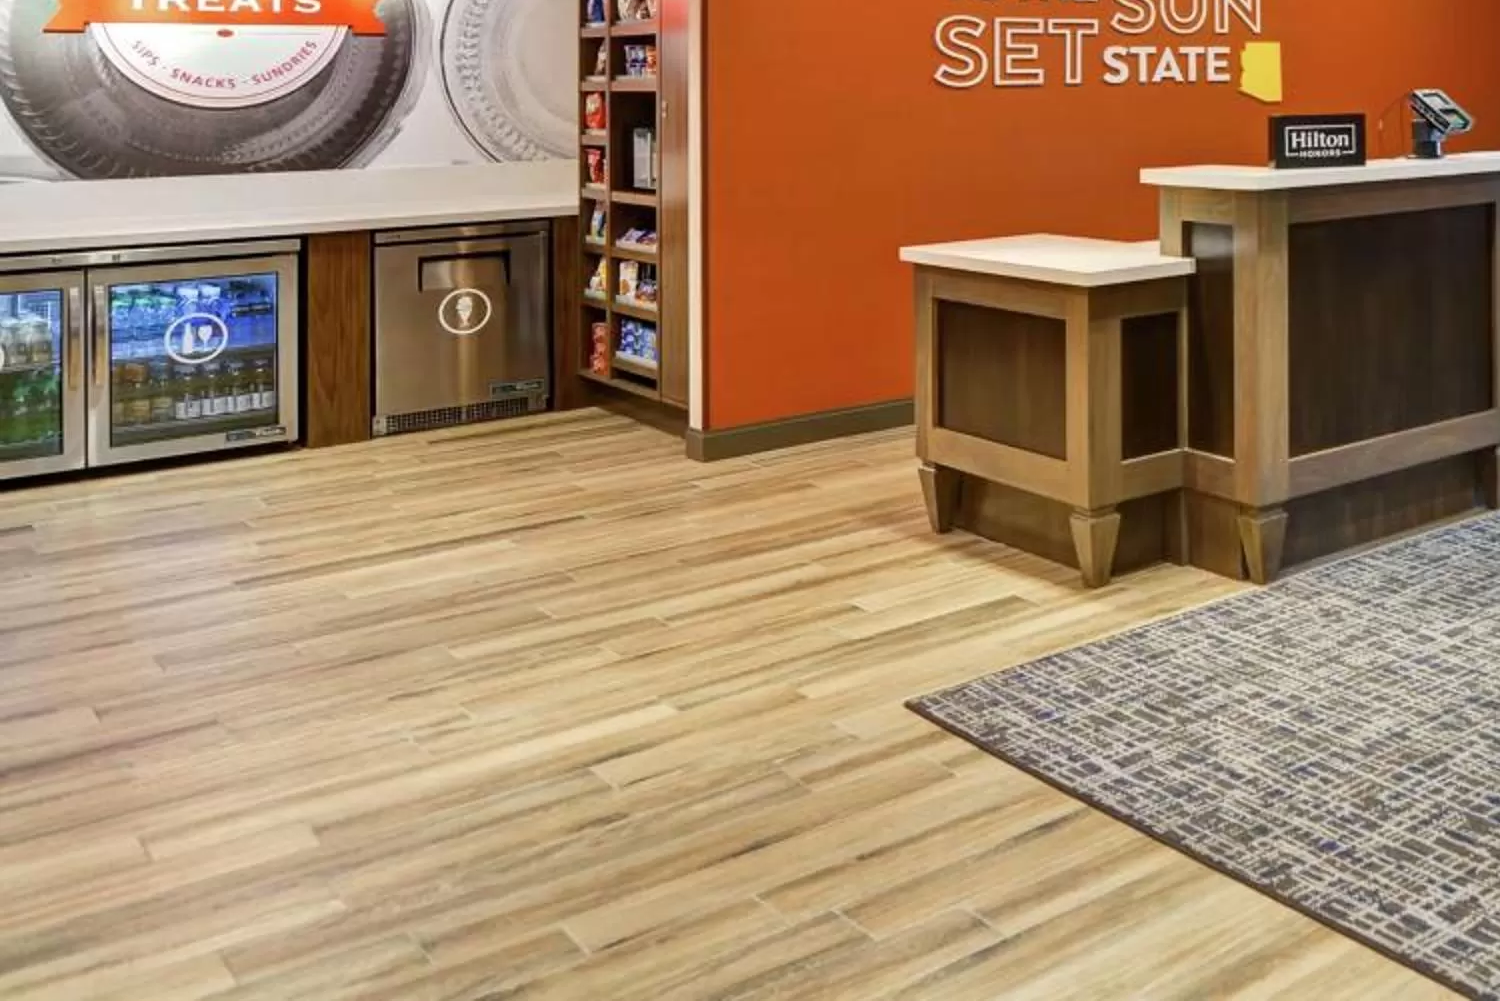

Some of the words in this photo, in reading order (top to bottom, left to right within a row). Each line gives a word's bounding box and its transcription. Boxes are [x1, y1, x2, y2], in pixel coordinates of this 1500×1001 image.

[132, 40, 160, 66] SIPS
[170, 67, 236, 89] SNACKS
[251, 40, 318, 85] SUNDRIES
[934, 14, 1099, 88] SET
[1103, 46, 1231, 85] STATE
[1291, 130, 1349, 149] Hilton
